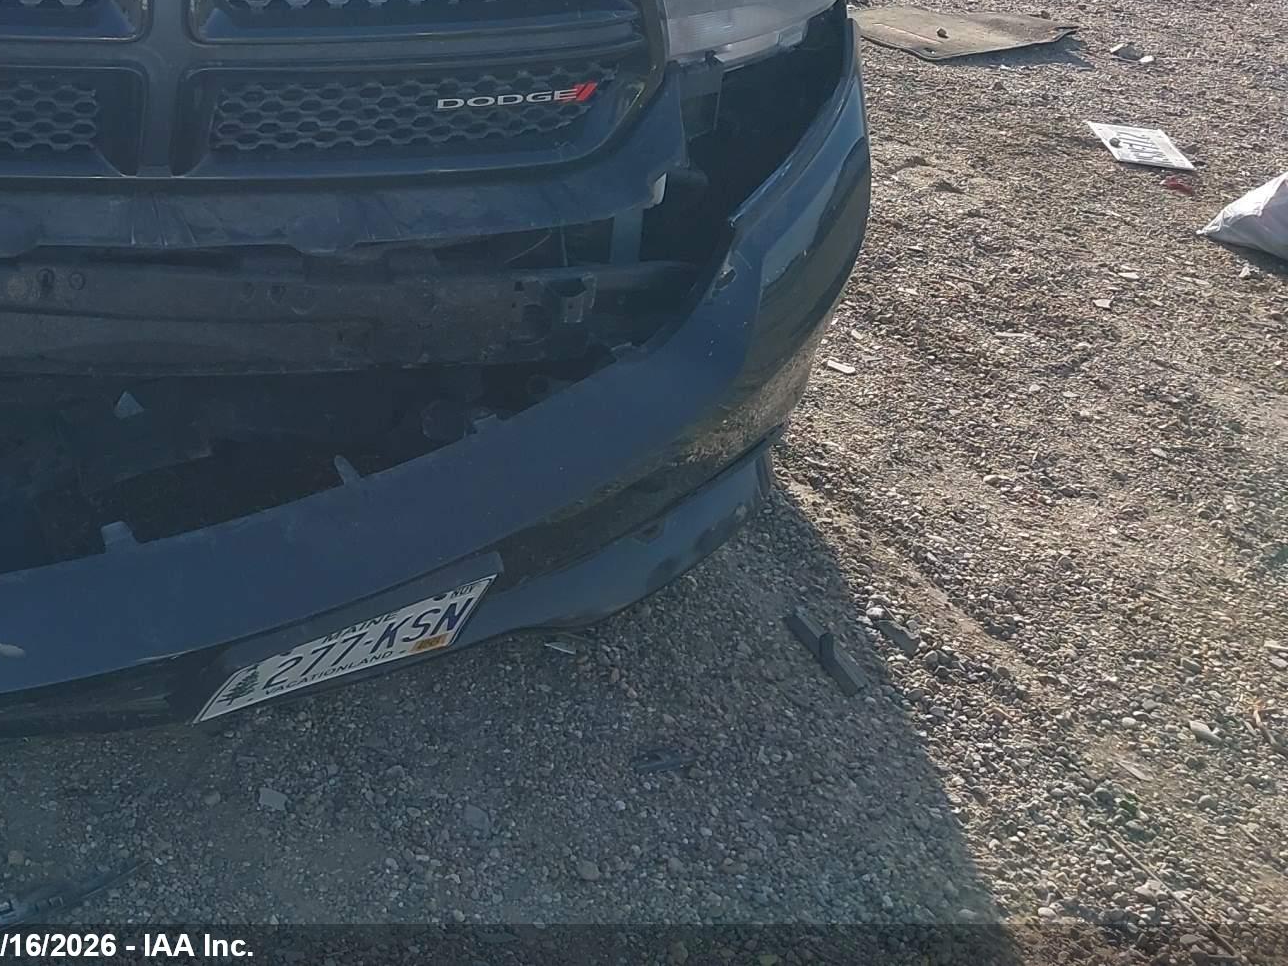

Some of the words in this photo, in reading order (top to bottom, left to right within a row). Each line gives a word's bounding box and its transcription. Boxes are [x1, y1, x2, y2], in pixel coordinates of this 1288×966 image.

[437, 88, 578, 110] DODGE
[262, 597, 474, 690] 277-KSN
[322, 612, 399, 644] MAINE
[265, 649, 394, 696] VACATIONLAND
